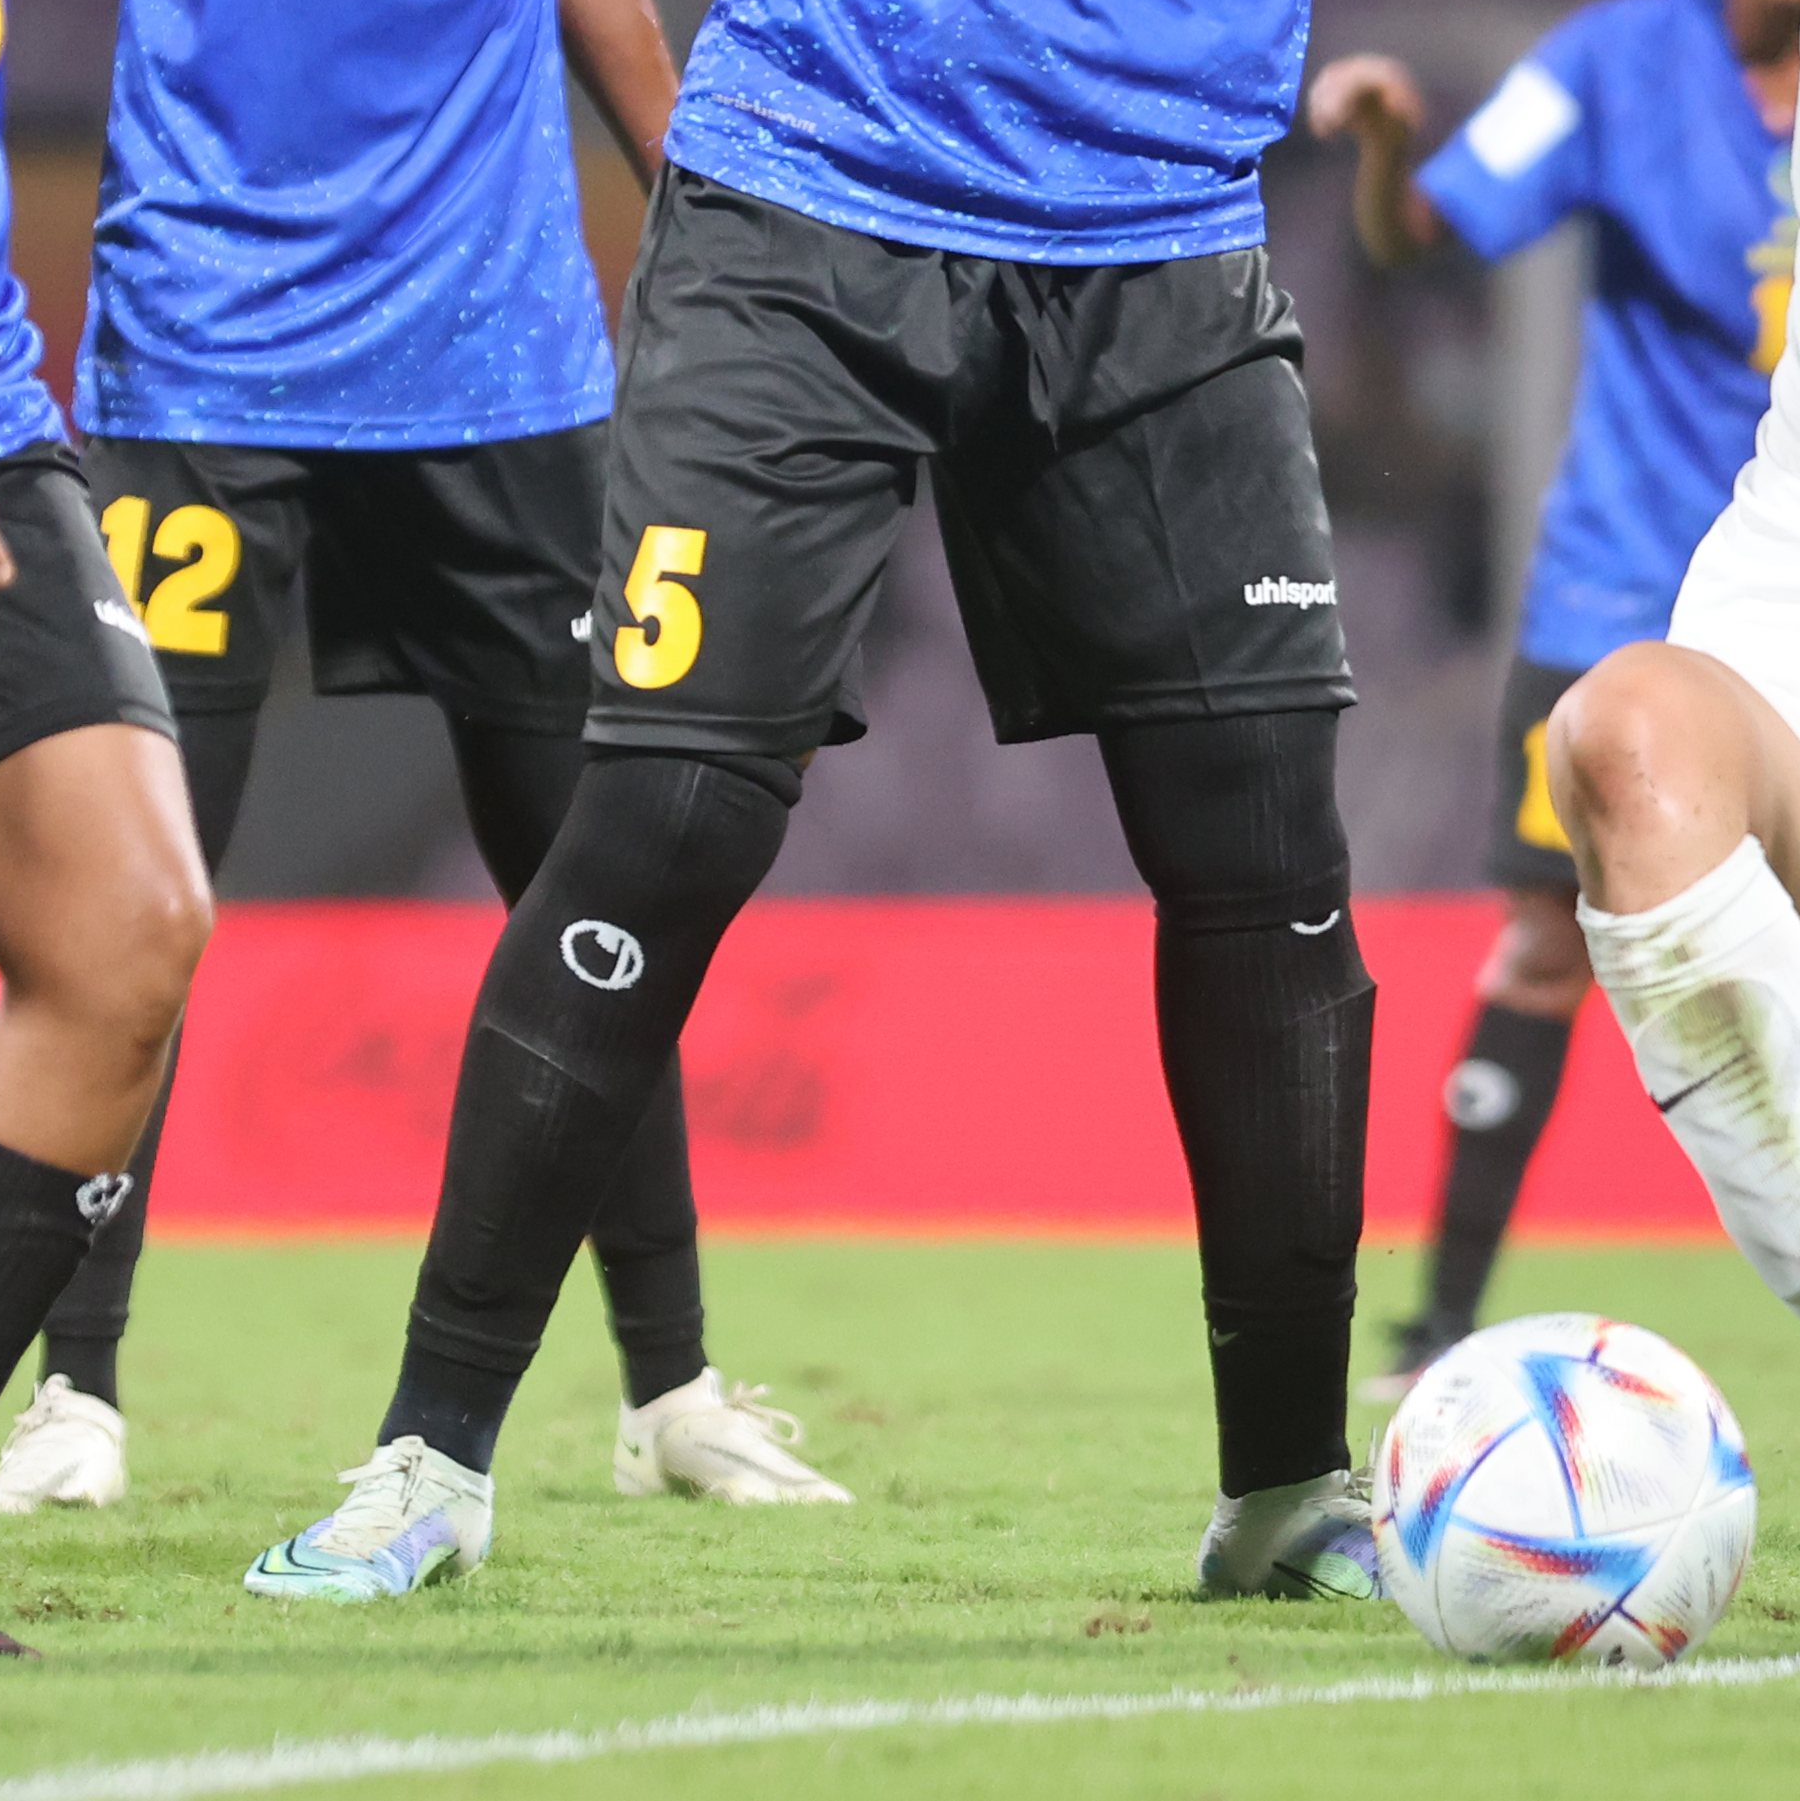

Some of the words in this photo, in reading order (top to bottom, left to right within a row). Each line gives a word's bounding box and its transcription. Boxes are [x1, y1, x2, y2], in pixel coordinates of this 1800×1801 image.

[100, 495, 242, 657] 12
[614, 525, 708, 690] 5
[1243, 575, 1337, 610] uhlsport
